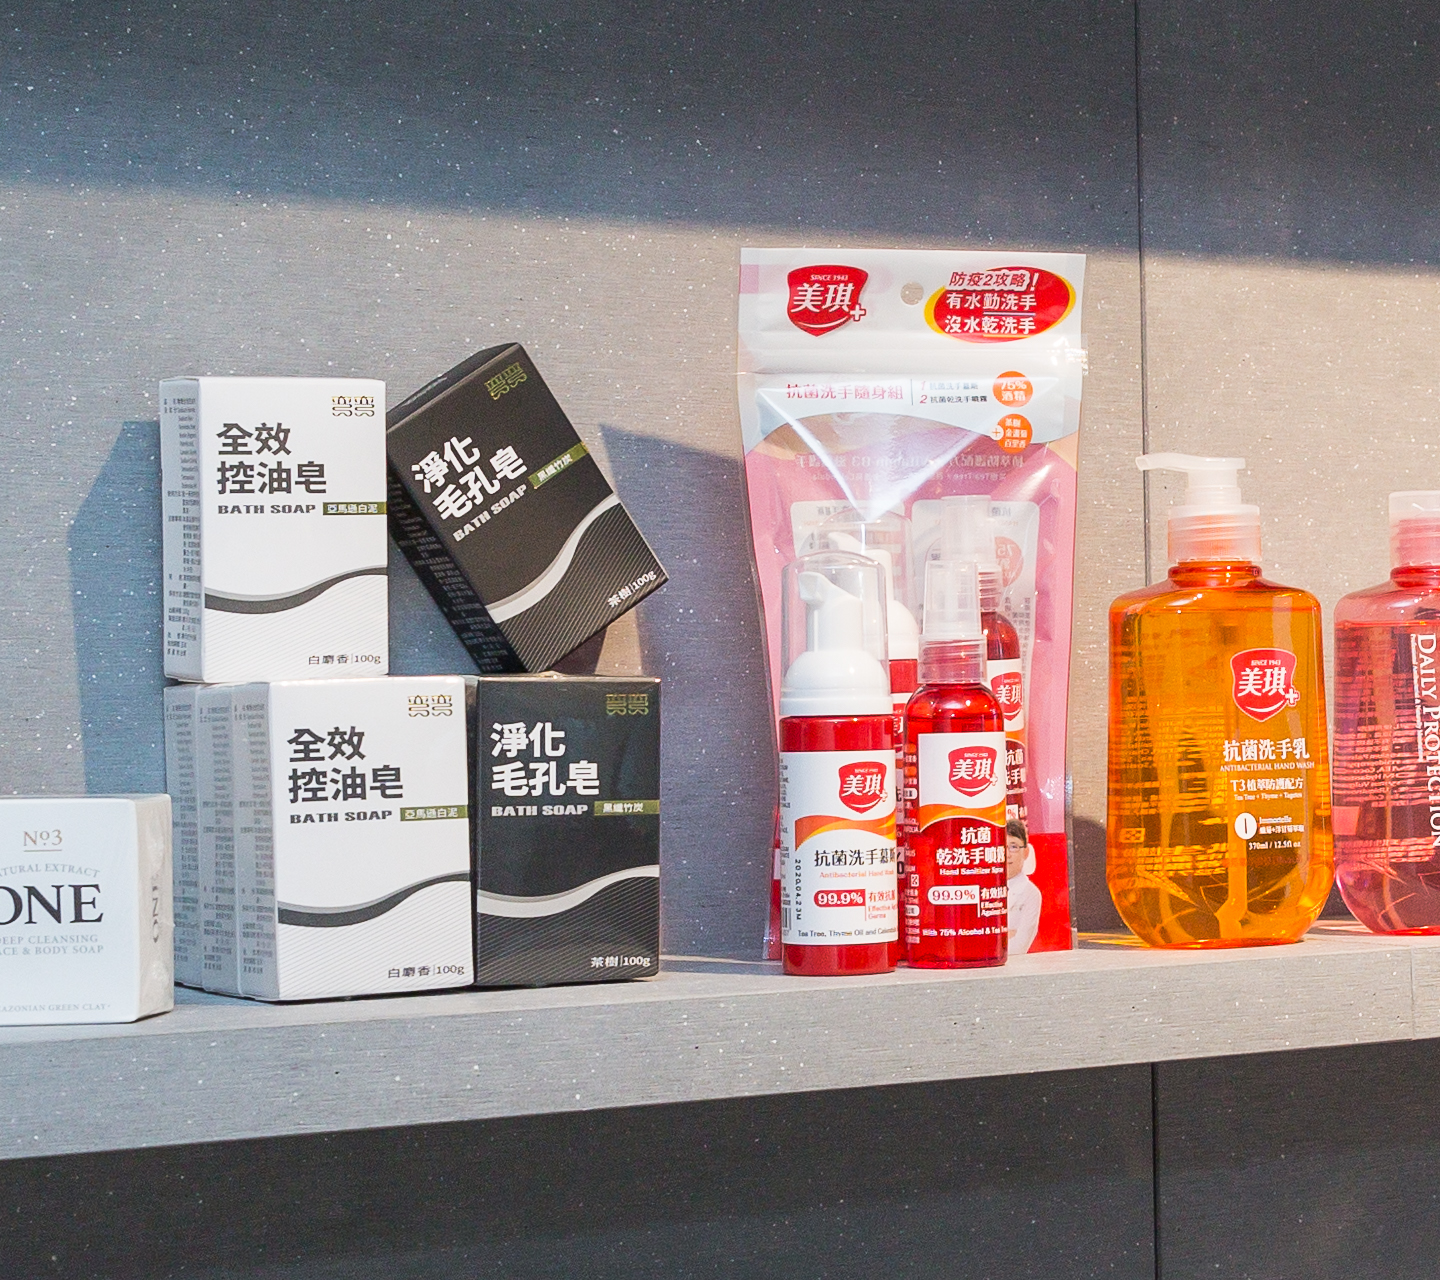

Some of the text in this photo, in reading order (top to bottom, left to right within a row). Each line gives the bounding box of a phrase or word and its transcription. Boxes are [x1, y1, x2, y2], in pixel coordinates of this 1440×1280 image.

[946, 292, 1037, 310] 有水勤洗手
[944, 316, 1036, 335] 沒水乾洗手
[786, 383, 904, 400] 抗菌洗手隨身組
[1001, 389, 1025, 402] 酒精
[217, 423, 292, 456] 全效
[411, 435, 481, 494] 淨化
[217, 461, 327, 495] 控油皂
[431, 445, 528, 521] 毛孔皂
[217, 504, 265, 515] BATH
[271, 504, 316, 515] SOAP
[1415, 633, 1438, 700] DAILY
[1238, 667, 1286, 697] 美琪
[287, 727, 366, 762] 全效
[490, 722, 566, 758] 淨化
[1223, 738, 1310, 762] 抗菌洗手乳
[952, 759, 991, 781] 美琪
[1220, 763, 1273, 772] ANTIBACTERIAL
[288, 765, 404, 803] 控油皂
[491, 761, 600, 796] 毛孔皂
[843, 775, 882, 796] 美琪
[289, 810, 393, 824] BATH SOAP
[961, 827, 991, 844] 抗菌
[817, 893, 863, 905] 99.9%
[932, 890, 976, 901] 99.9%
[28, 934, 99, 945] CLEANSING
